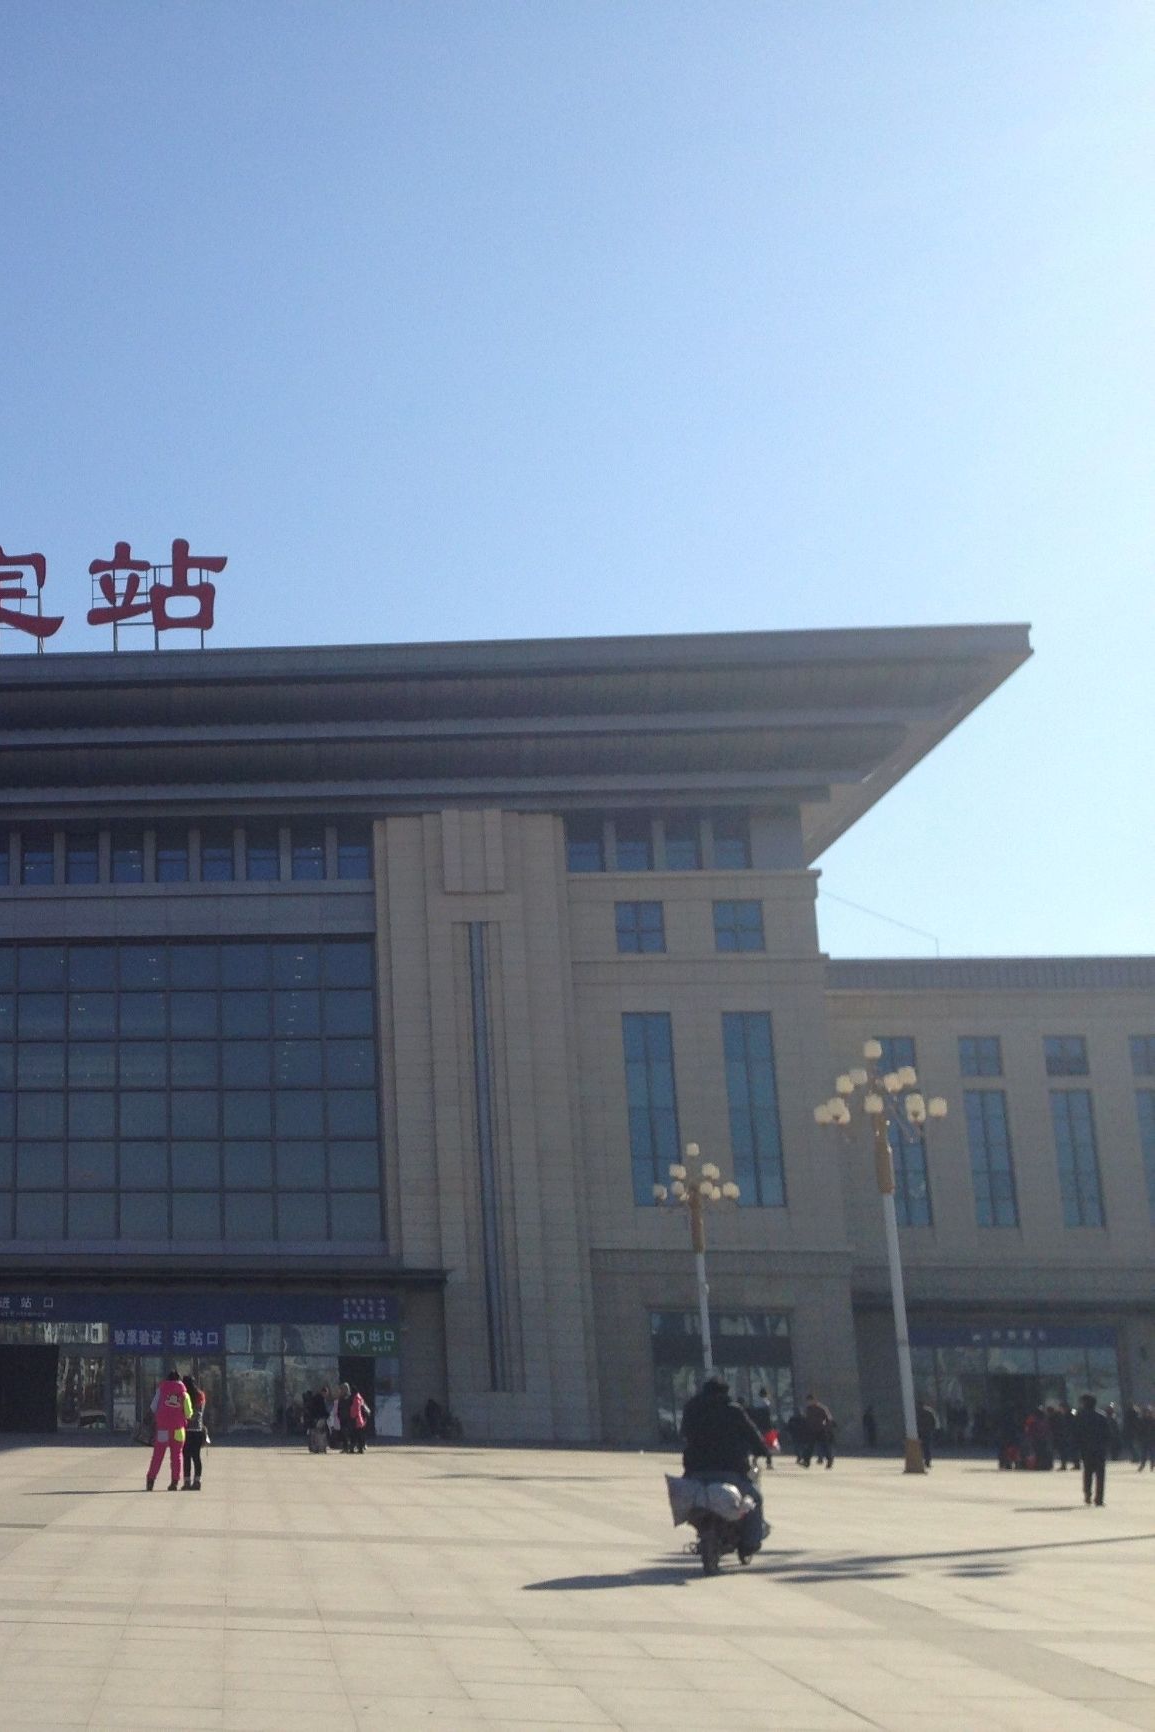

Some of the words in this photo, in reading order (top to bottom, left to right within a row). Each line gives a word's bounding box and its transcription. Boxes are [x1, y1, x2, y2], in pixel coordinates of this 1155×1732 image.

[173, 1330, 218, 1346] 进站口
[369, 1329, 395, 1342] 出口
